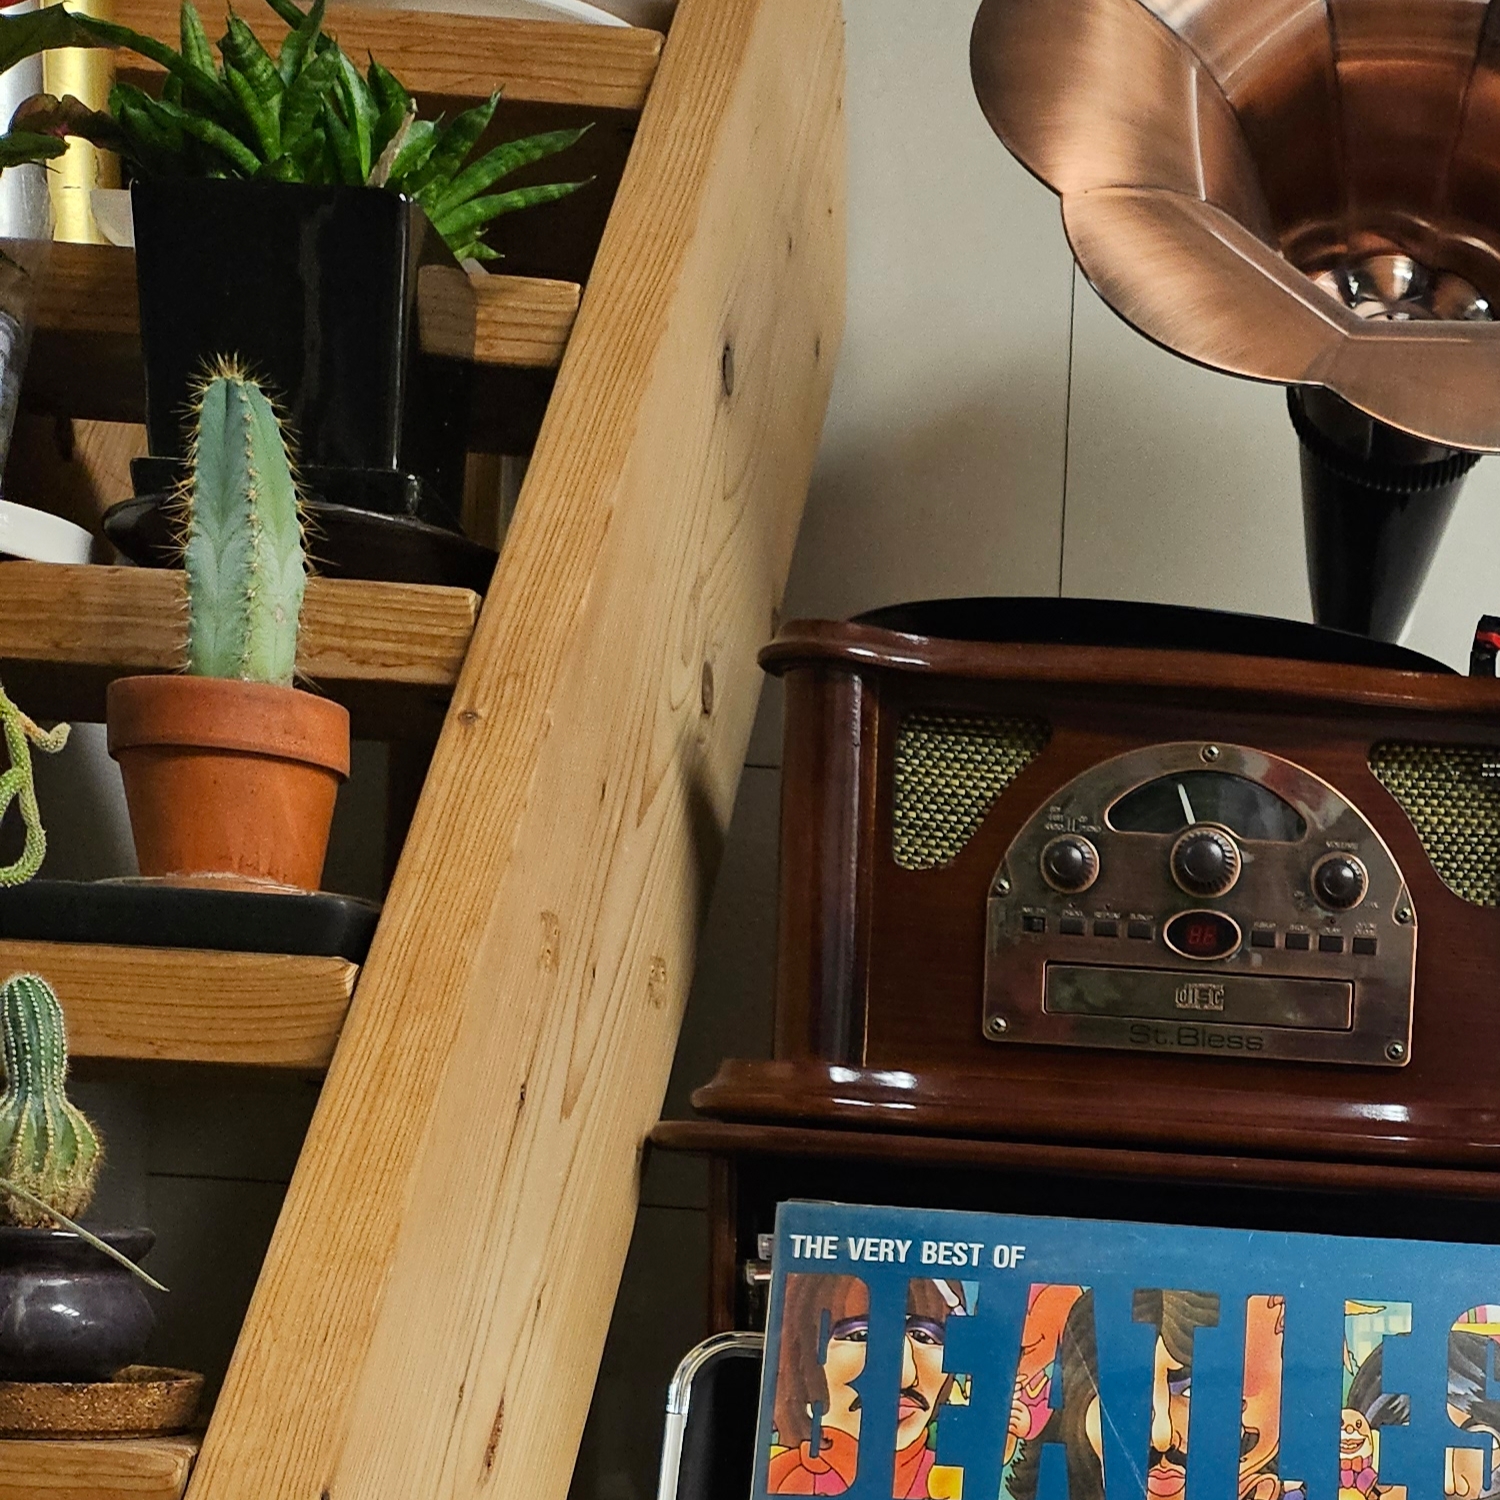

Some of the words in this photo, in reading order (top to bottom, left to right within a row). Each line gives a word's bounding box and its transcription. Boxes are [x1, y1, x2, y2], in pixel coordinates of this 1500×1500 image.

[1129, 1023, 1264, 1051] St.Bless
[790, 1234, 839, 1260] THE
[847, 1237, 912, 1263] VERY
[921, 1241, 984, 1267] BEST
[993, 1245, 1026, 1269] OF
